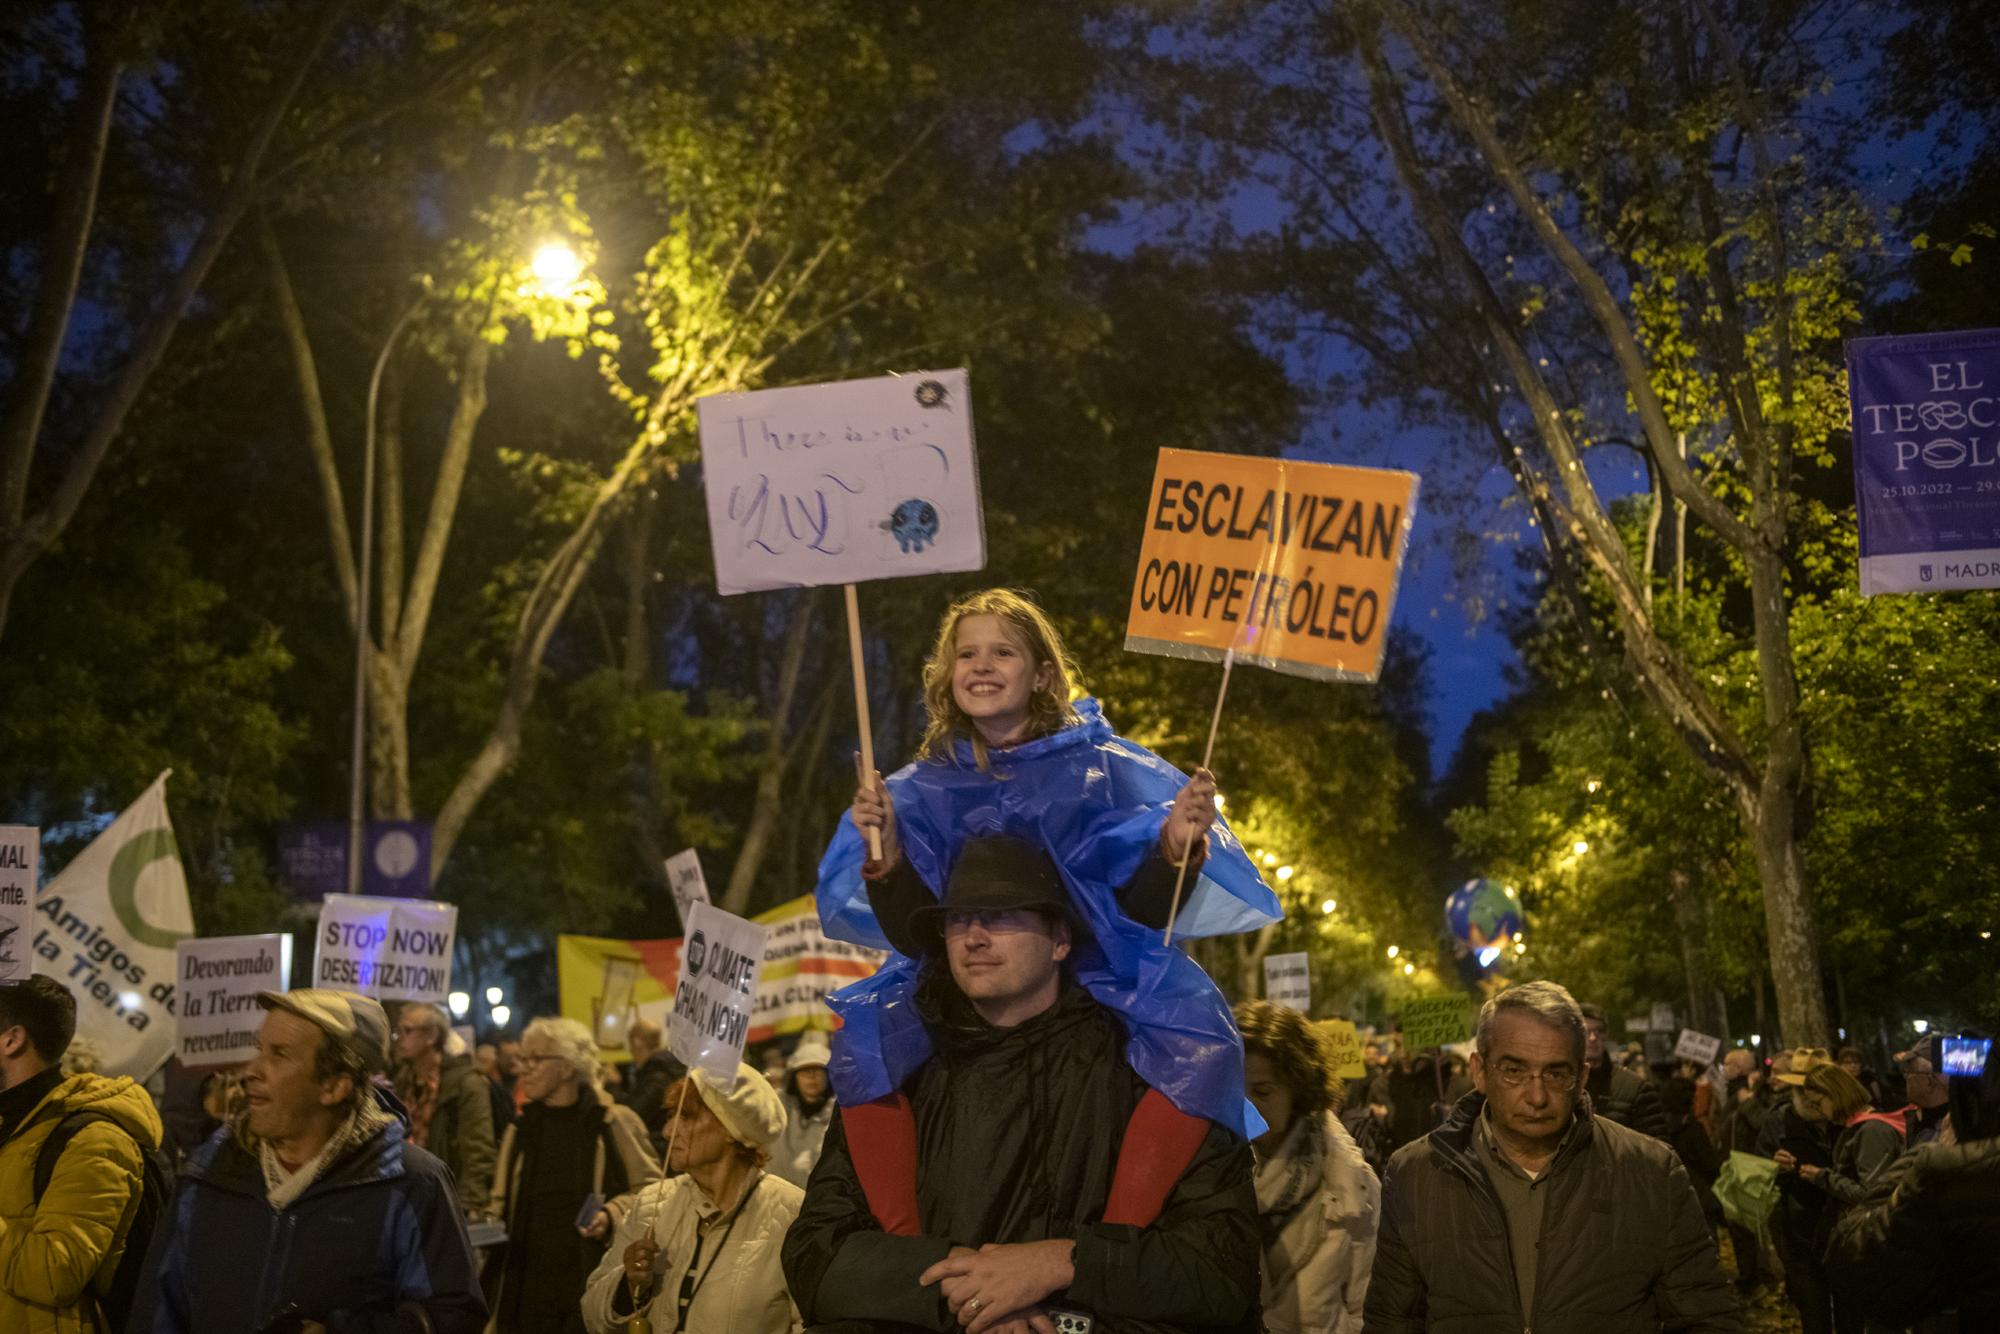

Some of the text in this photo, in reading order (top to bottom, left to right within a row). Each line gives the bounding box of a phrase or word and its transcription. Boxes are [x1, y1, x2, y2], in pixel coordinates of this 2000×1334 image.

[1928, 361, 1984, 392] EL
[1882, 483, 1953, 499] 25.10.2022
[1153, 478, 1402, 561] ESCLAVIZAN
[1140, 558, 1379, 645] CON PETRÓLEO
[33, 929, 61, 962] la
[36, 896, 146, 984] Amigos
[326, 921, 448, 956] STOP NOW
[184, 948, 275, 980] Devorando
[321, 957, 446, 993] DESERTIZATION!
[708, 941, 755, 995] CLIMATE
[183, 987, 262, 1018] la Tierr
[1406, 1024, 1467, 1045] TIERRA
